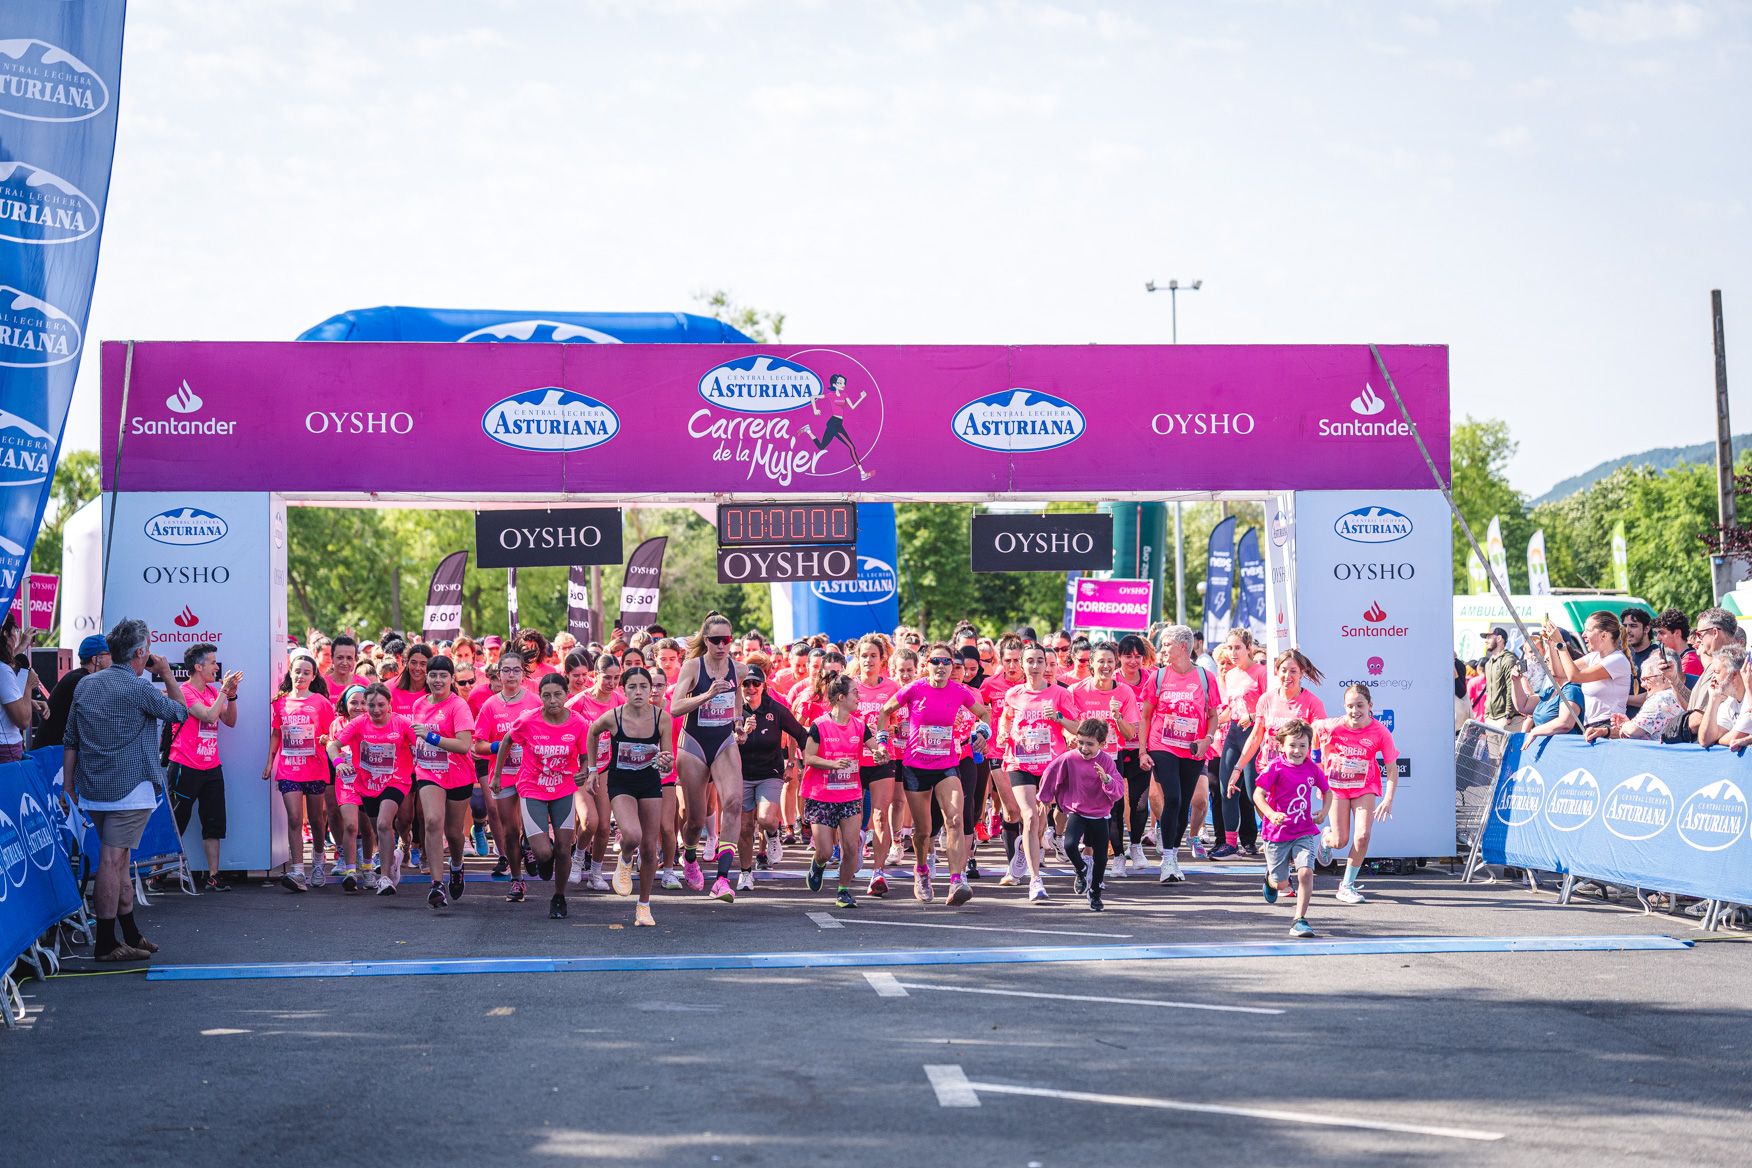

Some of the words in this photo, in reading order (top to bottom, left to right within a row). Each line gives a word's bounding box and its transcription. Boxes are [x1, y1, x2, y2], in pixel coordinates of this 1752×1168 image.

[44, 69, 92, 86] LECHERA
[29, 192, 82, 208] LECHERA
[13, 316, 67, 332] LECHERA
[708, 376, 813, 398] ASTURIANA
[131, 416, 237, 435] Santander
[305, 411, 414, 434] OYSHO
[493, 410, 609, 436] ASTURIANA
[687, 408, 790, 440] Carrera
[962, 412, 1075, 436] ASTURIANA
[1151, 412, 1255, 435] OYSHO
[1318, 418, 1417, 436] Santander
[712, 440, 732, 462] de
[735, 440, 750, 462] la
[746, 436, 829, 487] Mujer
[151, 521, 222, 536] ASTURIANA
[1340, 519, 1408, 534] ASTURIANA
[500, 525, 602, 550] OYSHO
[994, 532, 1094, 554] OYSHO
[630, 565, 659, 575] OYSHO
[724, 550, 851, 579] OYSHO
[1333, 562, 1415, 581] OYSHO
[143, 566, 230, 584] OYSHO
[433, 583, 461, 592] OYSHO
[817, 579, 893, 594] ASTURIANA
[1118, 586, 1149, 595] OYSHO
[625, 594, 656, 605] 6:30'
[1076, 601, 1148, 615] CORREDORAS
[1460, 605, 1532, 617] AMBULACIA
[150, 630, 223, 643] Santander
[1341, 625, 1409, 637] Santander
[1379, 680, 1414, 690] energy
[1163, 690, 1194, 701] CARRERA
[534, 744, 570, 756] CARRERA
[1547, 790, 1593, 815] ASTURIANA
[1605, 794, 1667, 826] ASTURIANA
[1680, 803, 1741, 834] ASTURIANA
